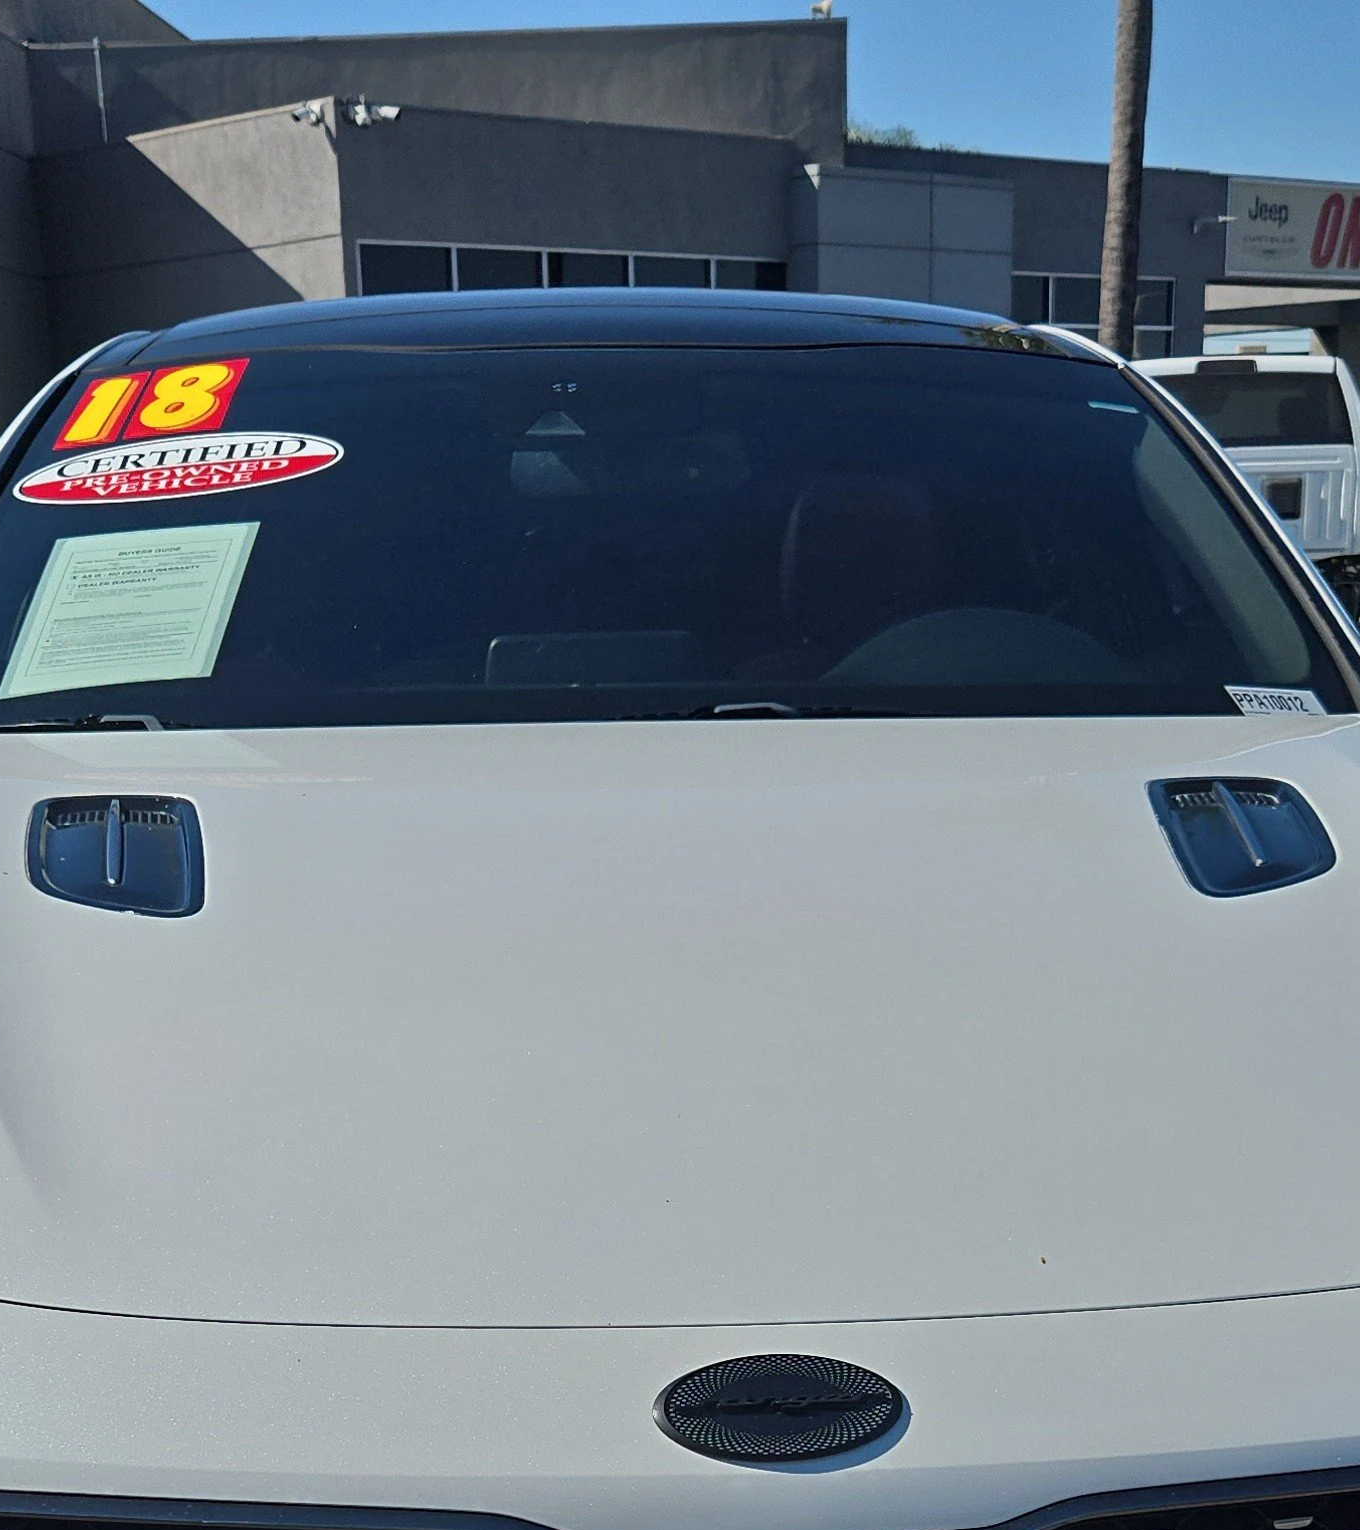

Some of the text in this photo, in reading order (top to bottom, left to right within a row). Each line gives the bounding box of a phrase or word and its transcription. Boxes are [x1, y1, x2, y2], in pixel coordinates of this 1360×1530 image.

[1248, 195, 1289, 228] Jeep
[63, 363, 235, 443] 18
[57, 439, 307, 478] CERTIFIED
[59, 459, 290, 492] PRE-OWNED
[91, 471, 253, 497] VEHICLE
[1232, 692, 1310, 713] PPA10012
